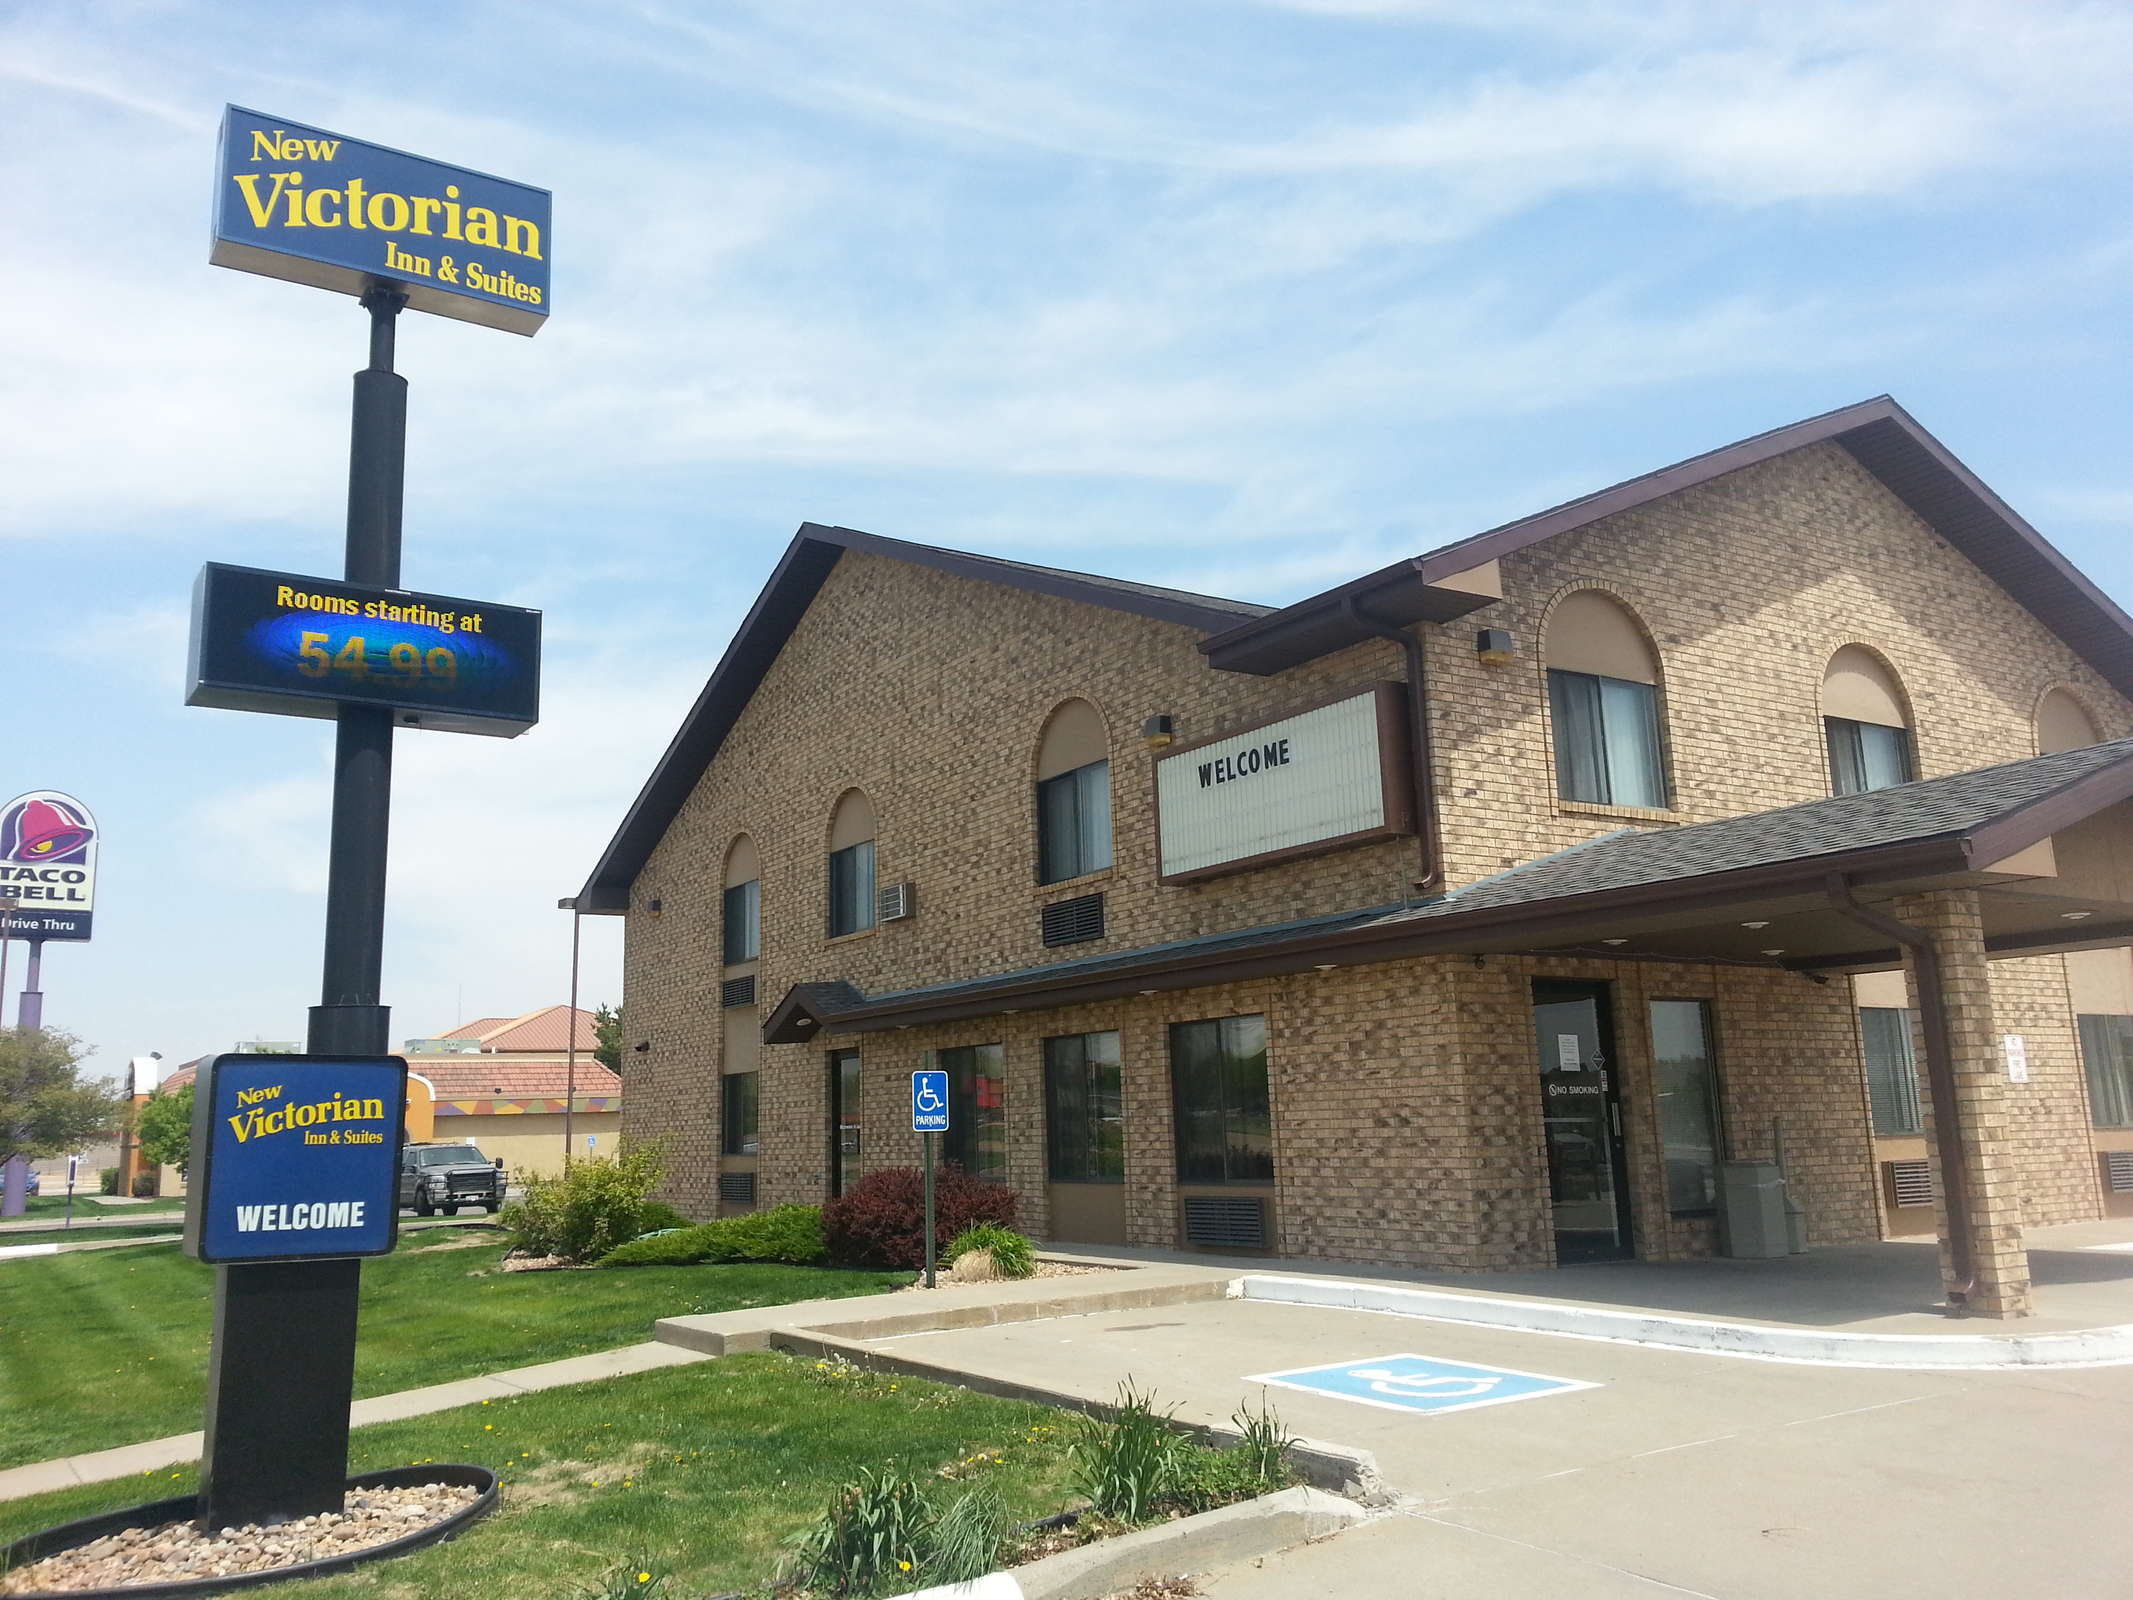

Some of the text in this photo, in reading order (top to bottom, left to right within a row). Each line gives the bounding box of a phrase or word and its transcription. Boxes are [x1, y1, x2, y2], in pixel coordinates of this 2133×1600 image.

[250, 129, 341, 161] New
[233, 170, 543, 261] Victorian
[385, 241, 542, 304] Inn & Suites
[277, 585, 482, 633] Rooms starting at
[1198, 738, 1290, 788] WELCOME
[0, 867, 86, 884] TACO
[0, 884, 86, 902] BELL
[43, 919, 74, 930] Thru
[236, 1085, 284, 1109] New
[1557, 1086, 1599, 1094] NO SMOKING
[228, 1092, 384, 1144] Victorian
[916, 1115, 946, 1125] PARKING
[304, 1130, 384, 1145] Inn & Suites
[236, 1202, 365, 1232] WELCOME
